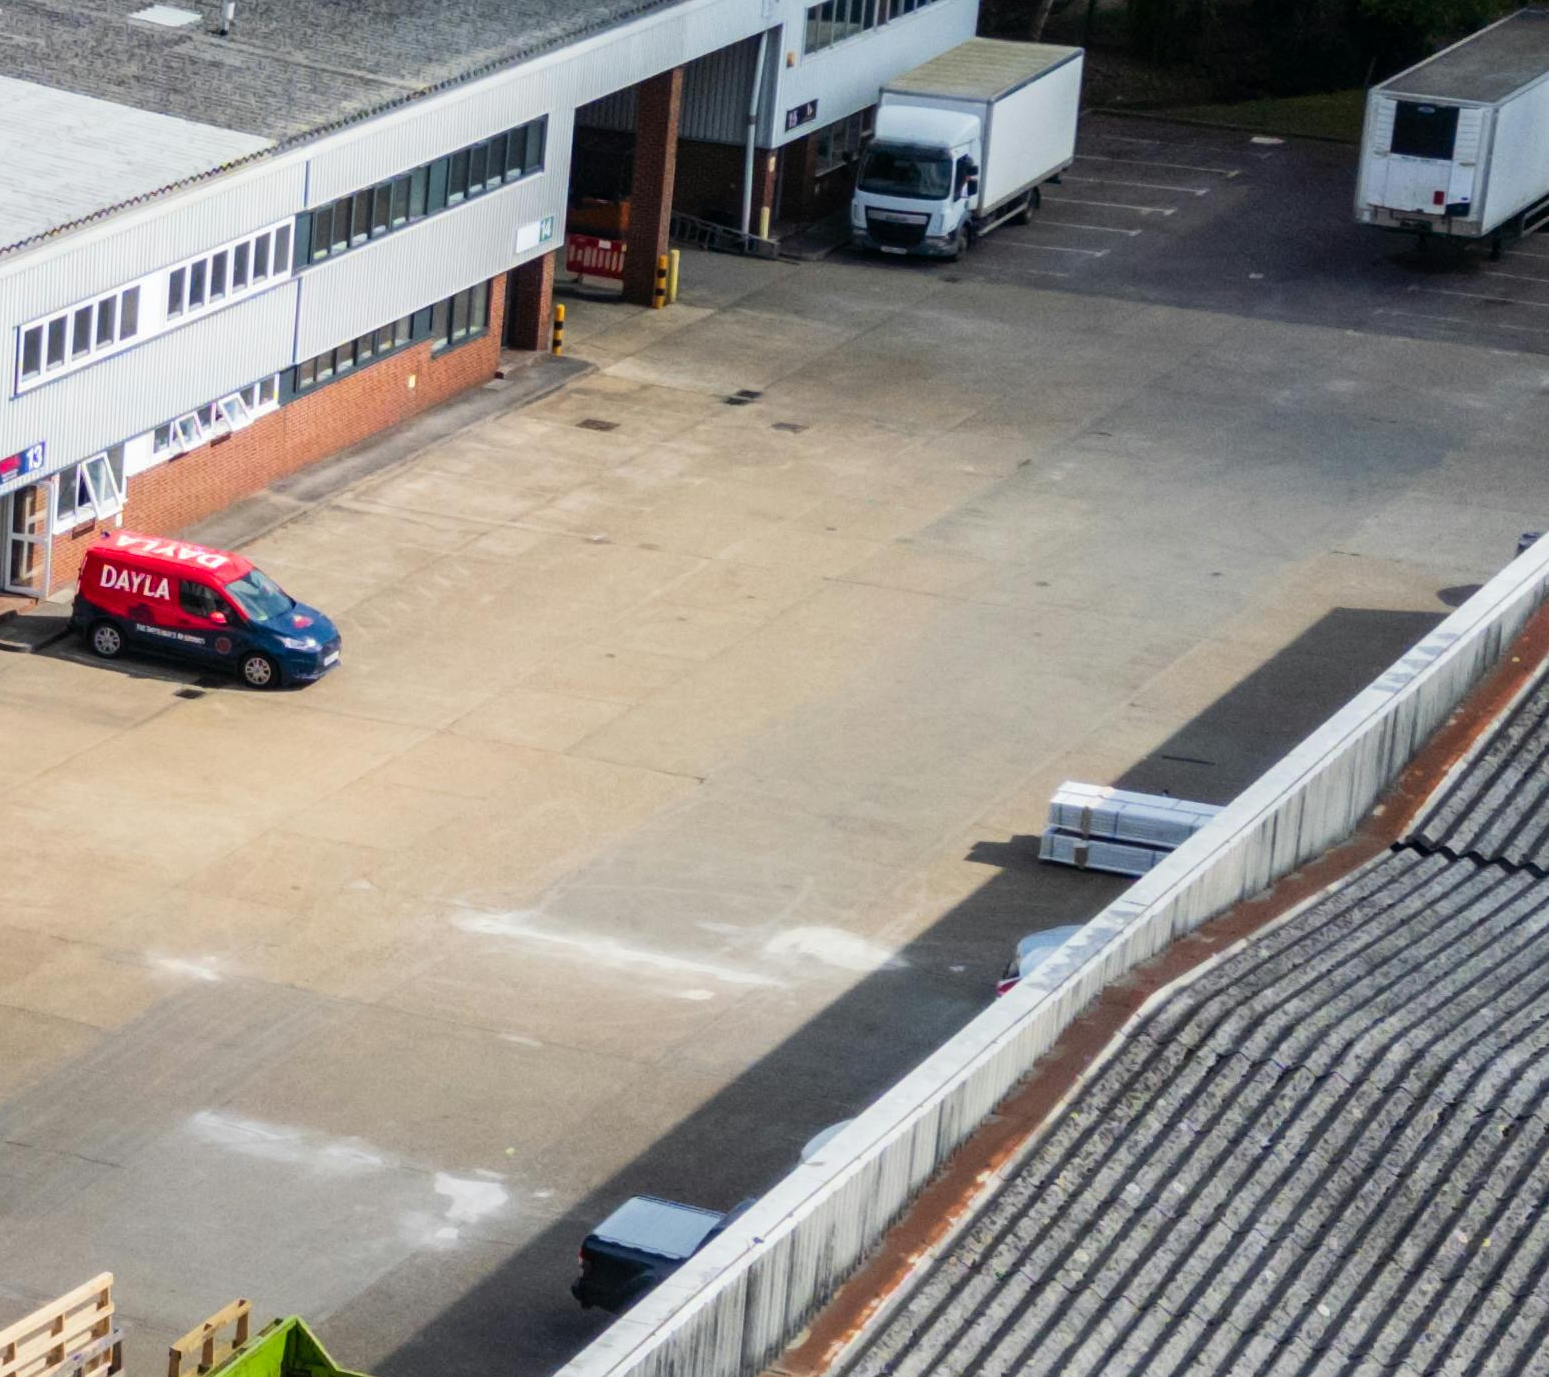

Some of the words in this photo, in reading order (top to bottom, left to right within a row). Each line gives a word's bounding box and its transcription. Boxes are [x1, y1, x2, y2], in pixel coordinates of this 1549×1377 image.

[26, 444, 43, 471] 13
[116, 534, 230, 569] DAYLA
[99, 564, 170, 601] DAYLA
